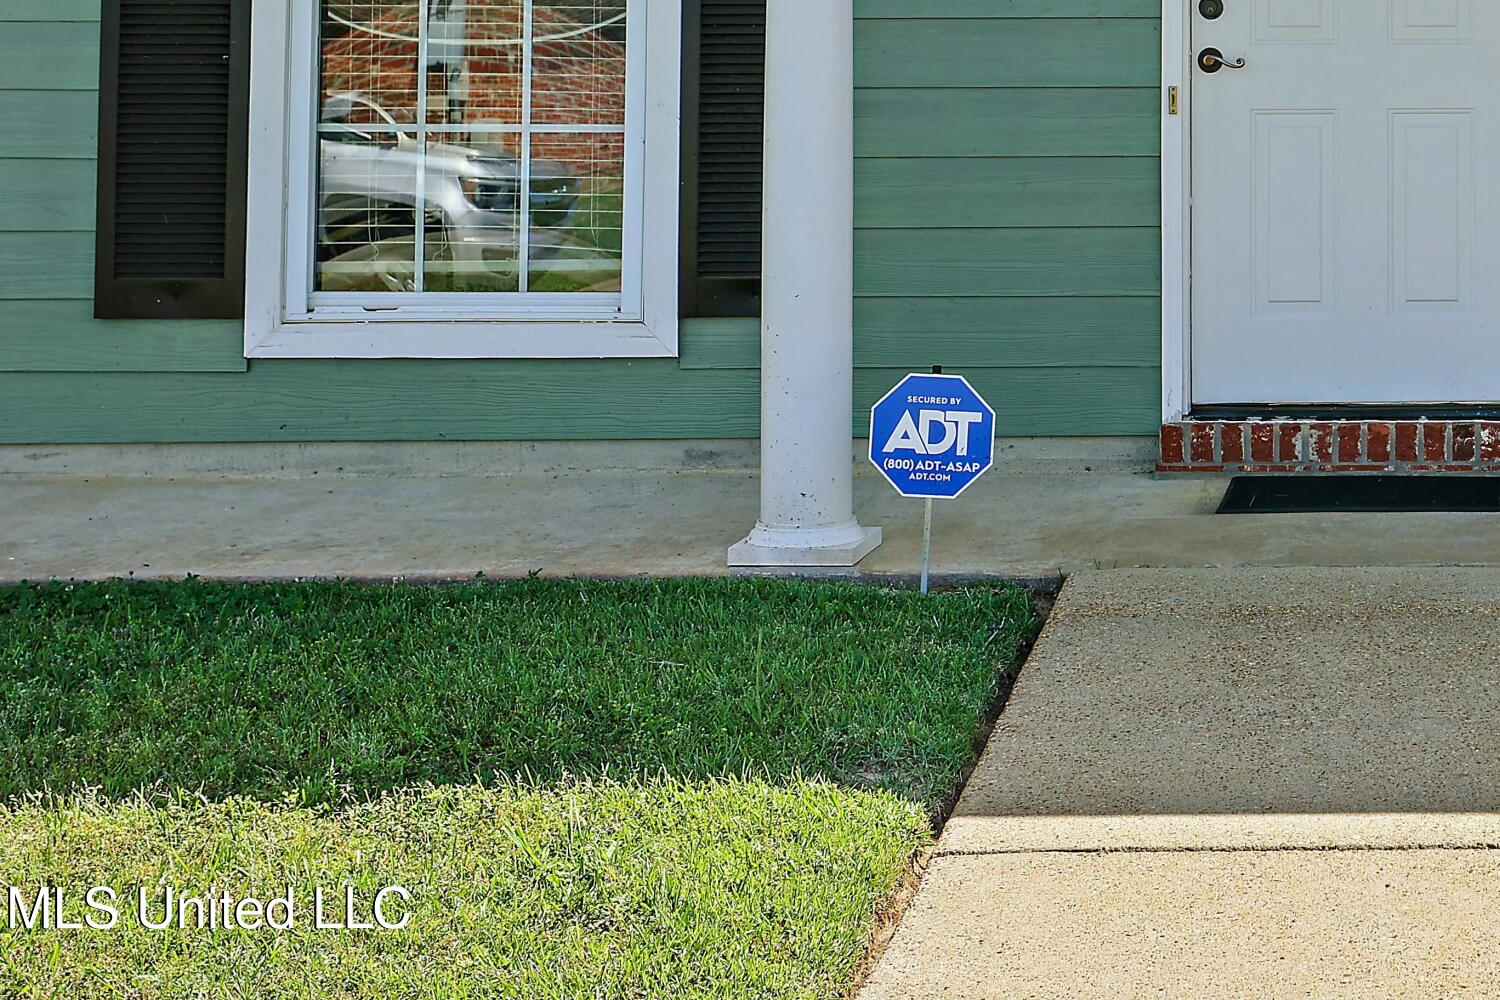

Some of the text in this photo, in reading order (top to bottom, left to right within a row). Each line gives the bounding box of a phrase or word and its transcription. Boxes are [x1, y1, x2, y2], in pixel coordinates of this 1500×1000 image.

[907, 395, 961, 405] SECURED BY
[882, 408, 983, 456] ADT
[883, 458, 980, 473] (800) ADT-ASAP
[908, 473, 951, 482] ADT.COM
